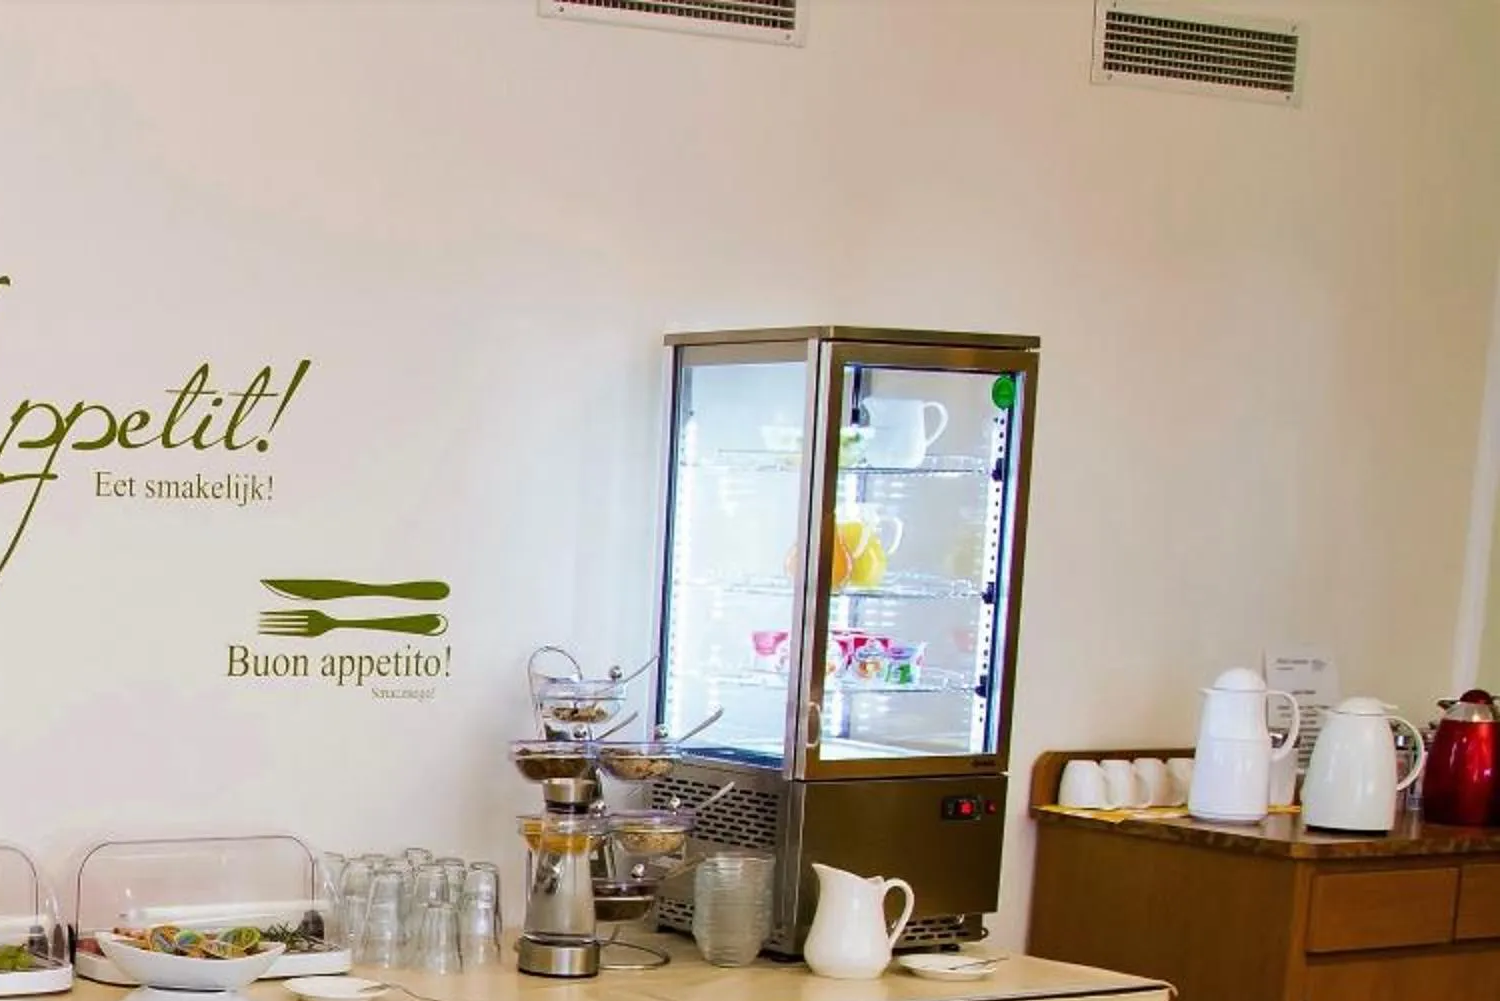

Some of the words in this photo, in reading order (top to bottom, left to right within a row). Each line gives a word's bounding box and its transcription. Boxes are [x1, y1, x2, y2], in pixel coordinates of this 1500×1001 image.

[94, 470, 137, 498] Eet
[145, 472, 274, 508] smakelijk!
[226, 643, 309, 678] Buon
[320, 643, 452, 687] appetito!
